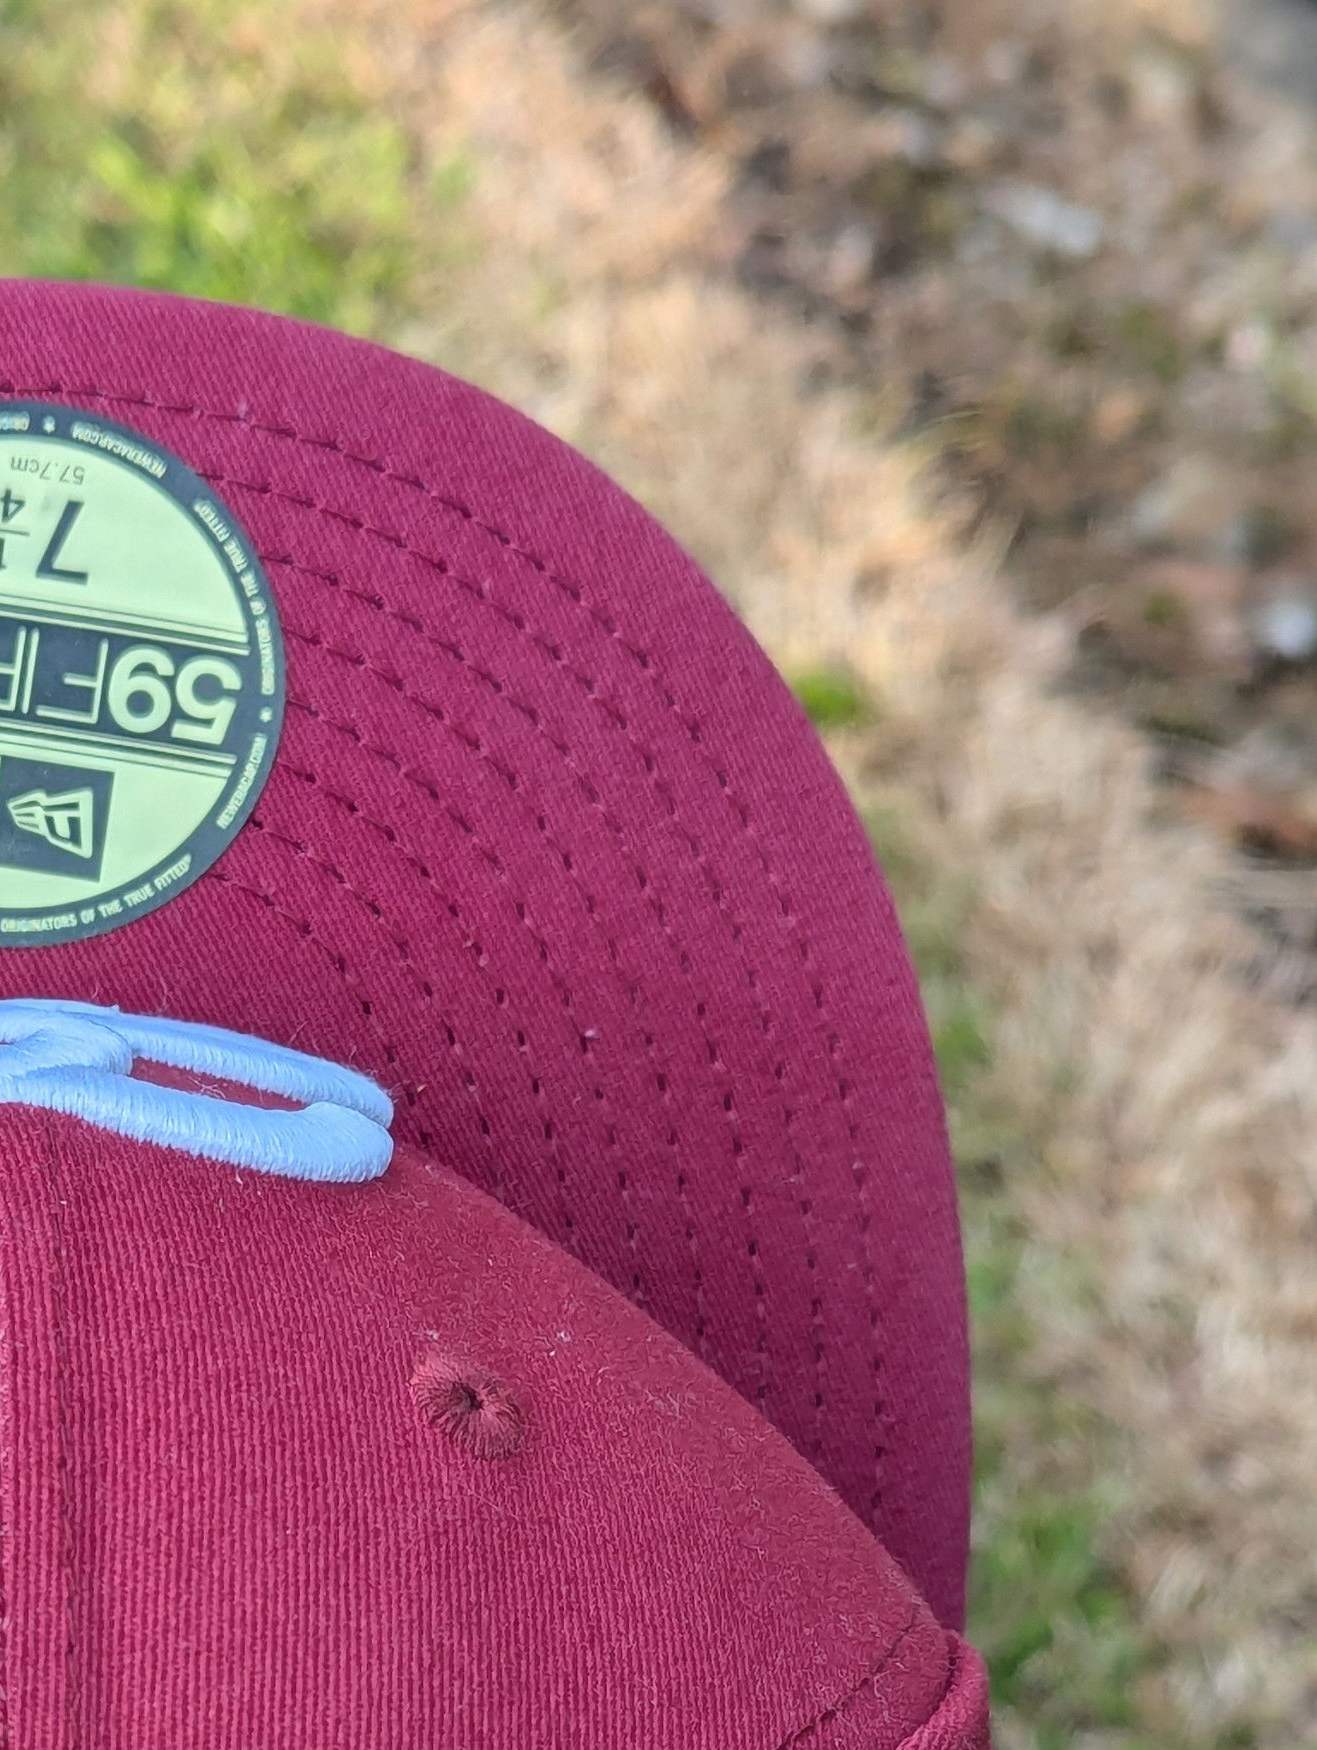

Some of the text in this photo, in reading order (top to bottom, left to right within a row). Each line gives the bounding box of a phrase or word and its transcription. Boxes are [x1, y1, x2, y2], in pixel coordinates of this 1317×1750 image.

[10, 456, 85, 485] 57.7cm
[35, 500, 88, 586] 7
[81, 908, 95, 924] OF
[98, 899, 123, 918] THE
[123, 884, 155, 907] TRUE
